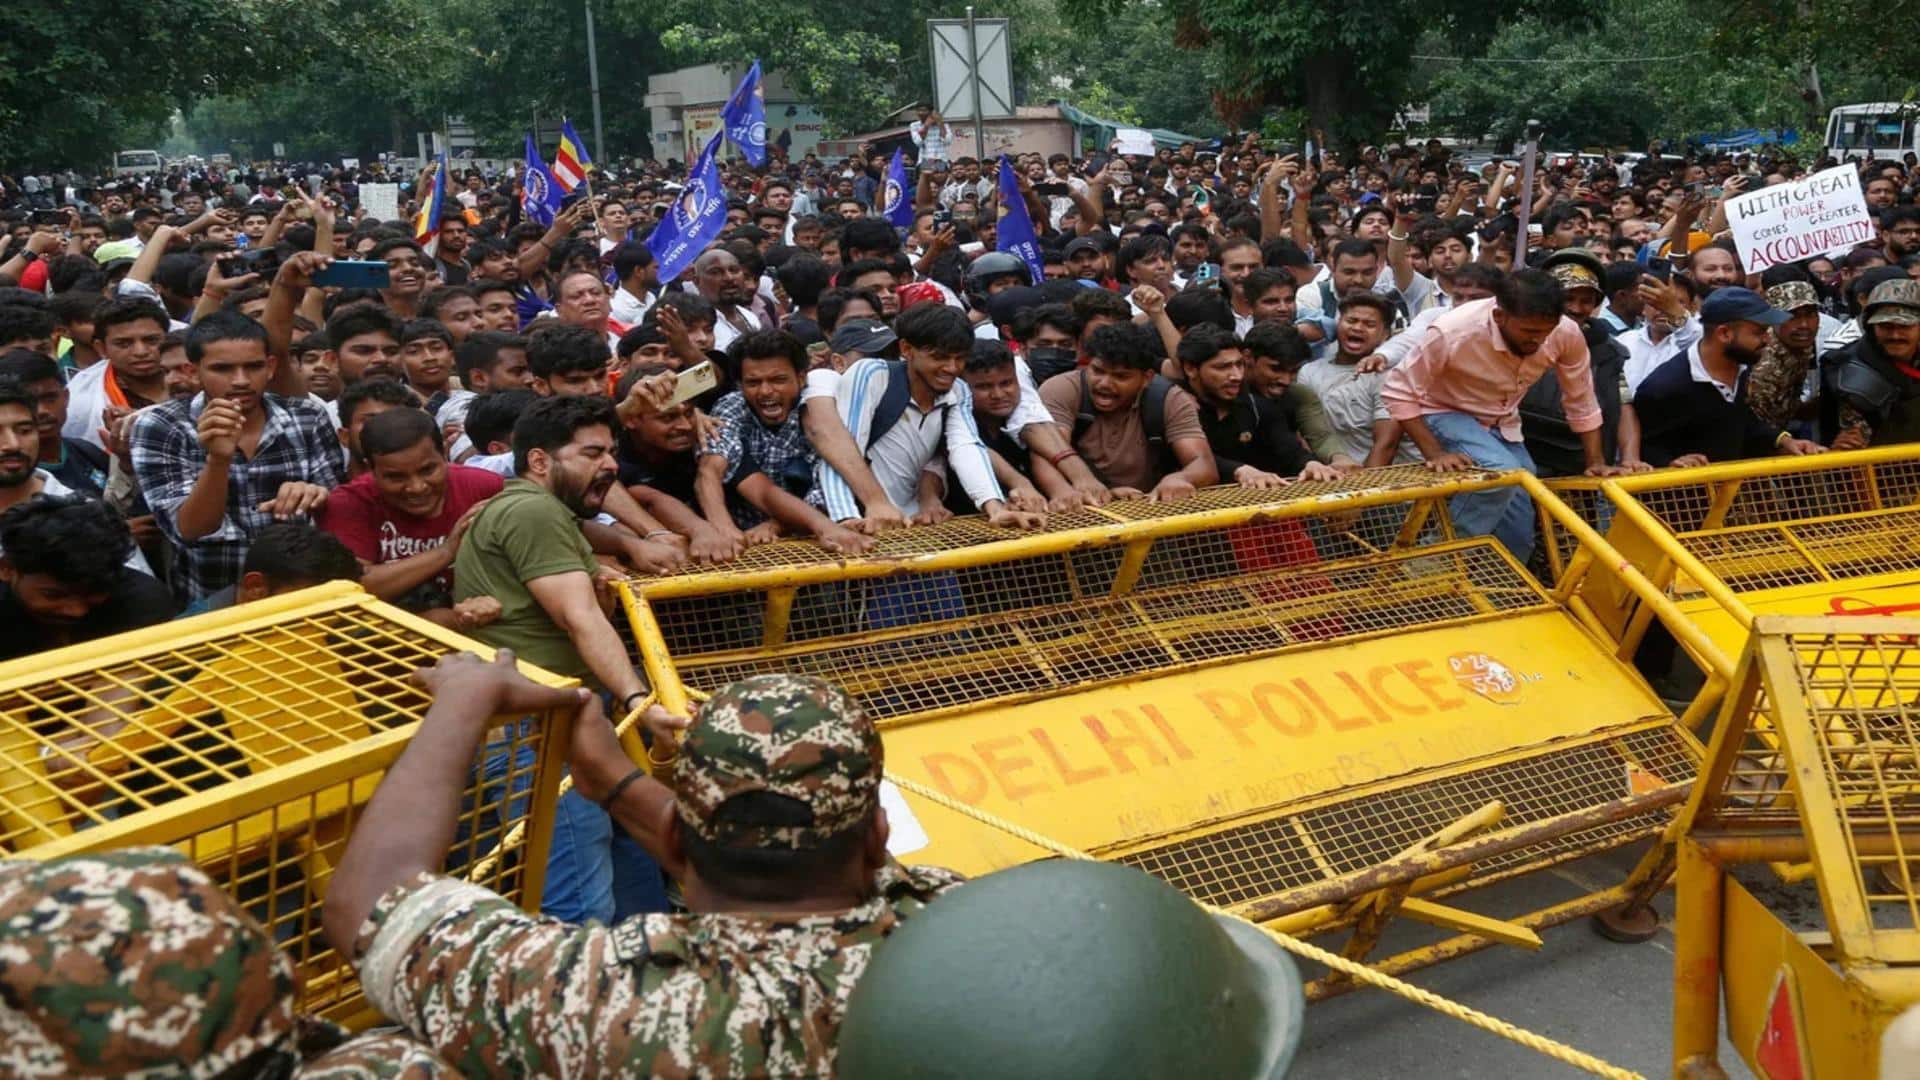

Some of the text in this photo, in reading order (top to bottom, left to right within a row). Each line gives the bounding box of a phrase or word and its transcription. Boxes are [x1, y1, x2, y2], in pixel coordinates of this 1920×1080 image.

[1738, 172, 1854, 220] WITH GREAT
[1782, 200, 1827, 221] POWER
[1750, 218, 1870, 272] ACCOUNTABILITY
[1752, 204, 1861, 241] COMES GREATER
[920, 703, 1195, 805] DELHI
[1194, 659, 1467, 748] POLICE
